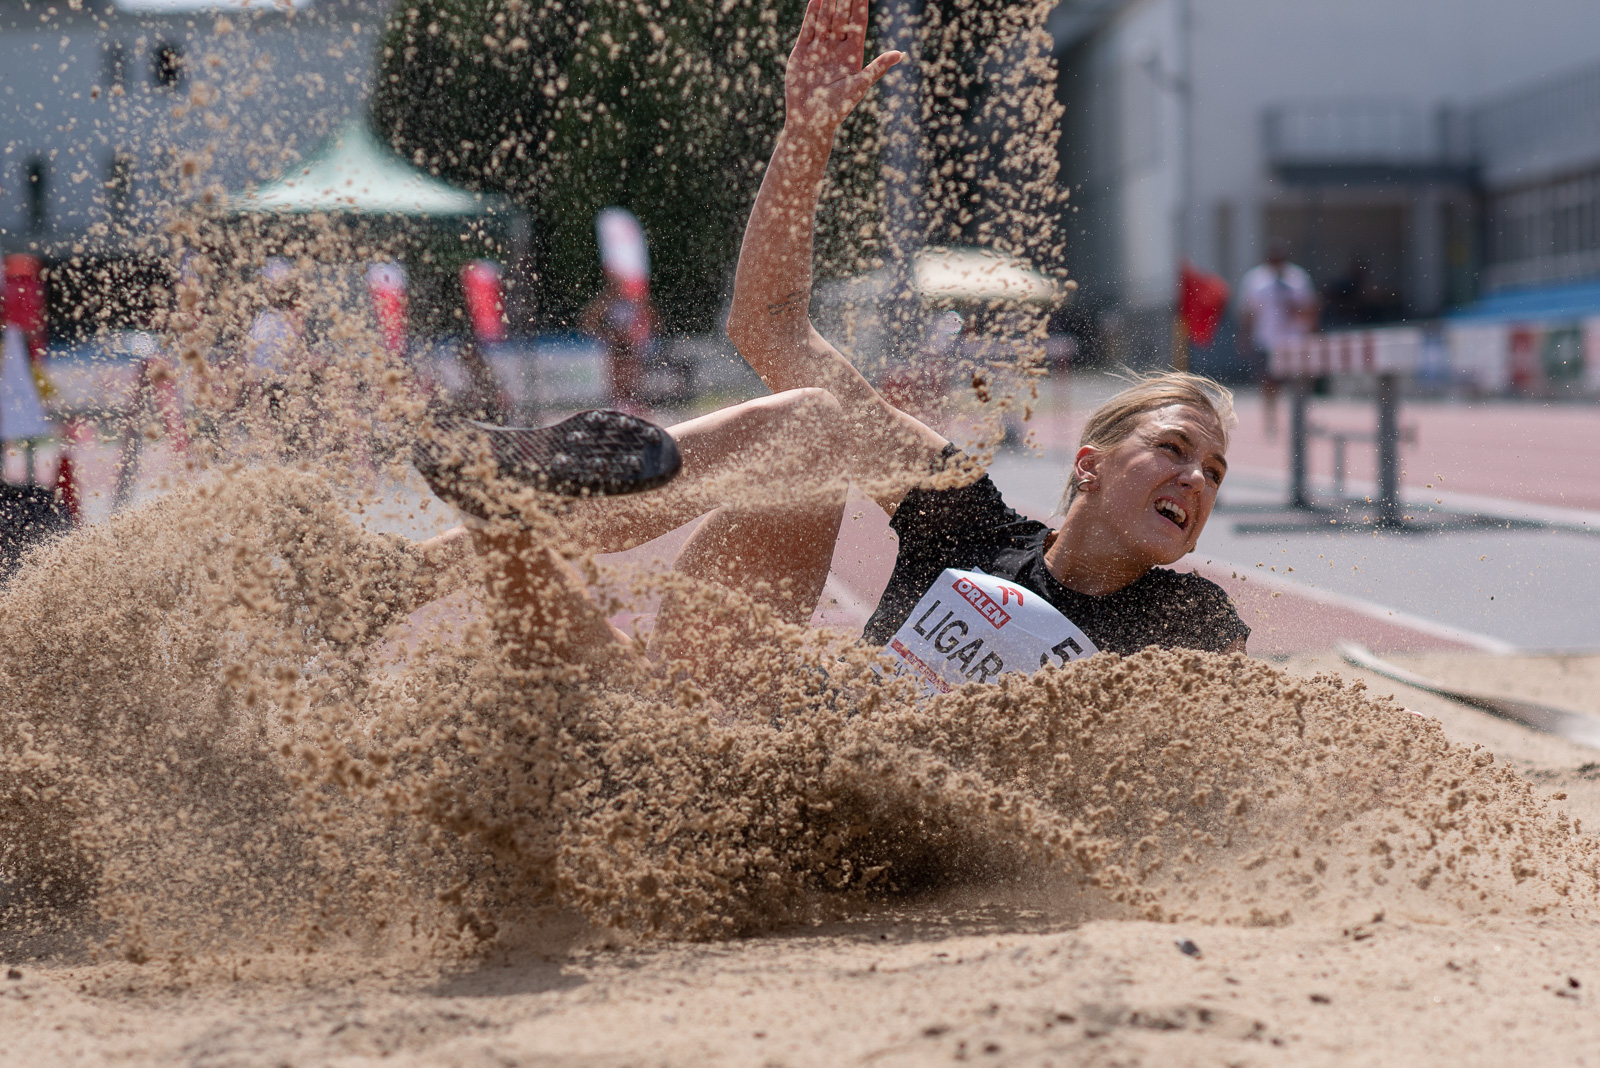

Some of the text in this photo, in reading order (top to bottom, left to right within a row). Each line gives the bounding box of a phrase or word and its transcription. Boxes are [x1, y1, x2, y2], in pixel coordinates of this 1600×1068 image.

[956, 579, 1008, 626] ORLEN
[913, 599, 1018, 685] LIGAR
[1039, 636, 1084, 670] 5
